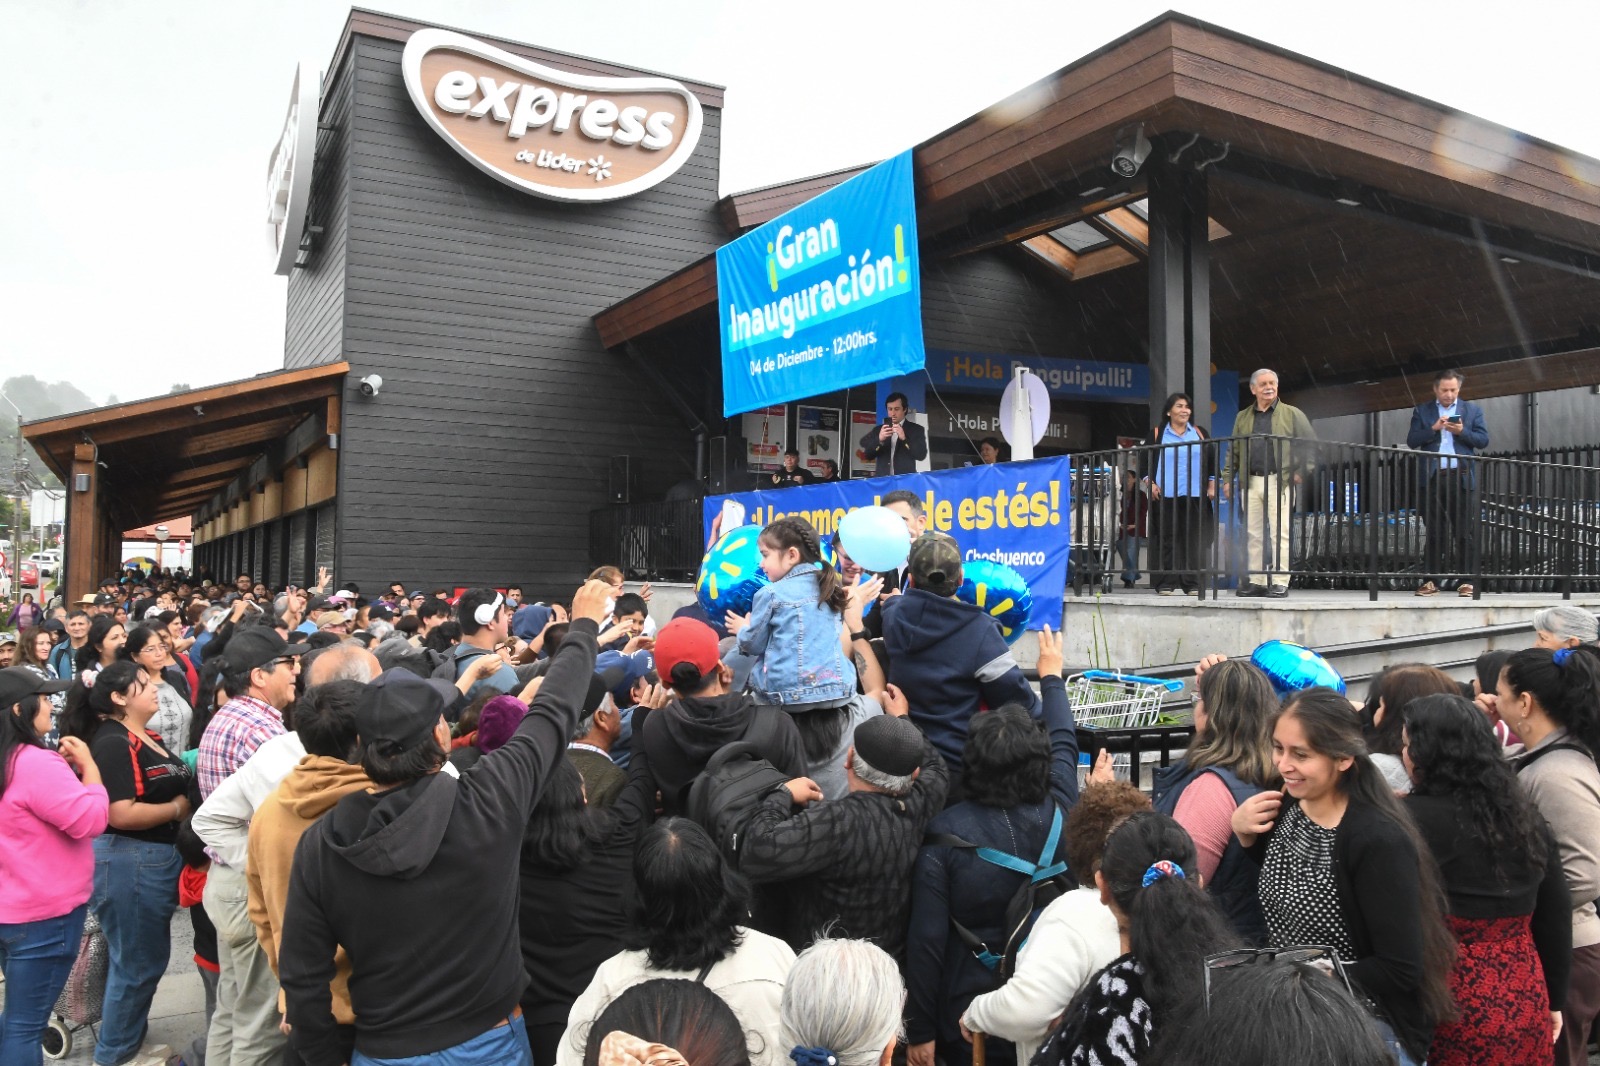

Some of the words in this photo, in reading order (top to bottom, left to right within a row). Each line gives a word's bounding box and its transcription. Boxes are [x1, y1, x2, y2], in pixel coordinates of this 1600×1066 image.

[434, 70, 676, 150] express
[516, 149, 536, 163] de
[536, 149, 587, 173] Lider
[767, 218, 838, 292] ¡Gran
[729, 223, 907, 339] Inauguración!
[749, 359, 762, 376] 04
[763, 356, 776, 373] de
[777, 345, 824, 370] Diciembre
[832, 330, 878, 355] 12:00hrs.
[945, 356, 1003, 382] ¡Hola
[1010, 360, 1132, 391] Pnguipulli!
[957, 480, 1061, 531] estés!
